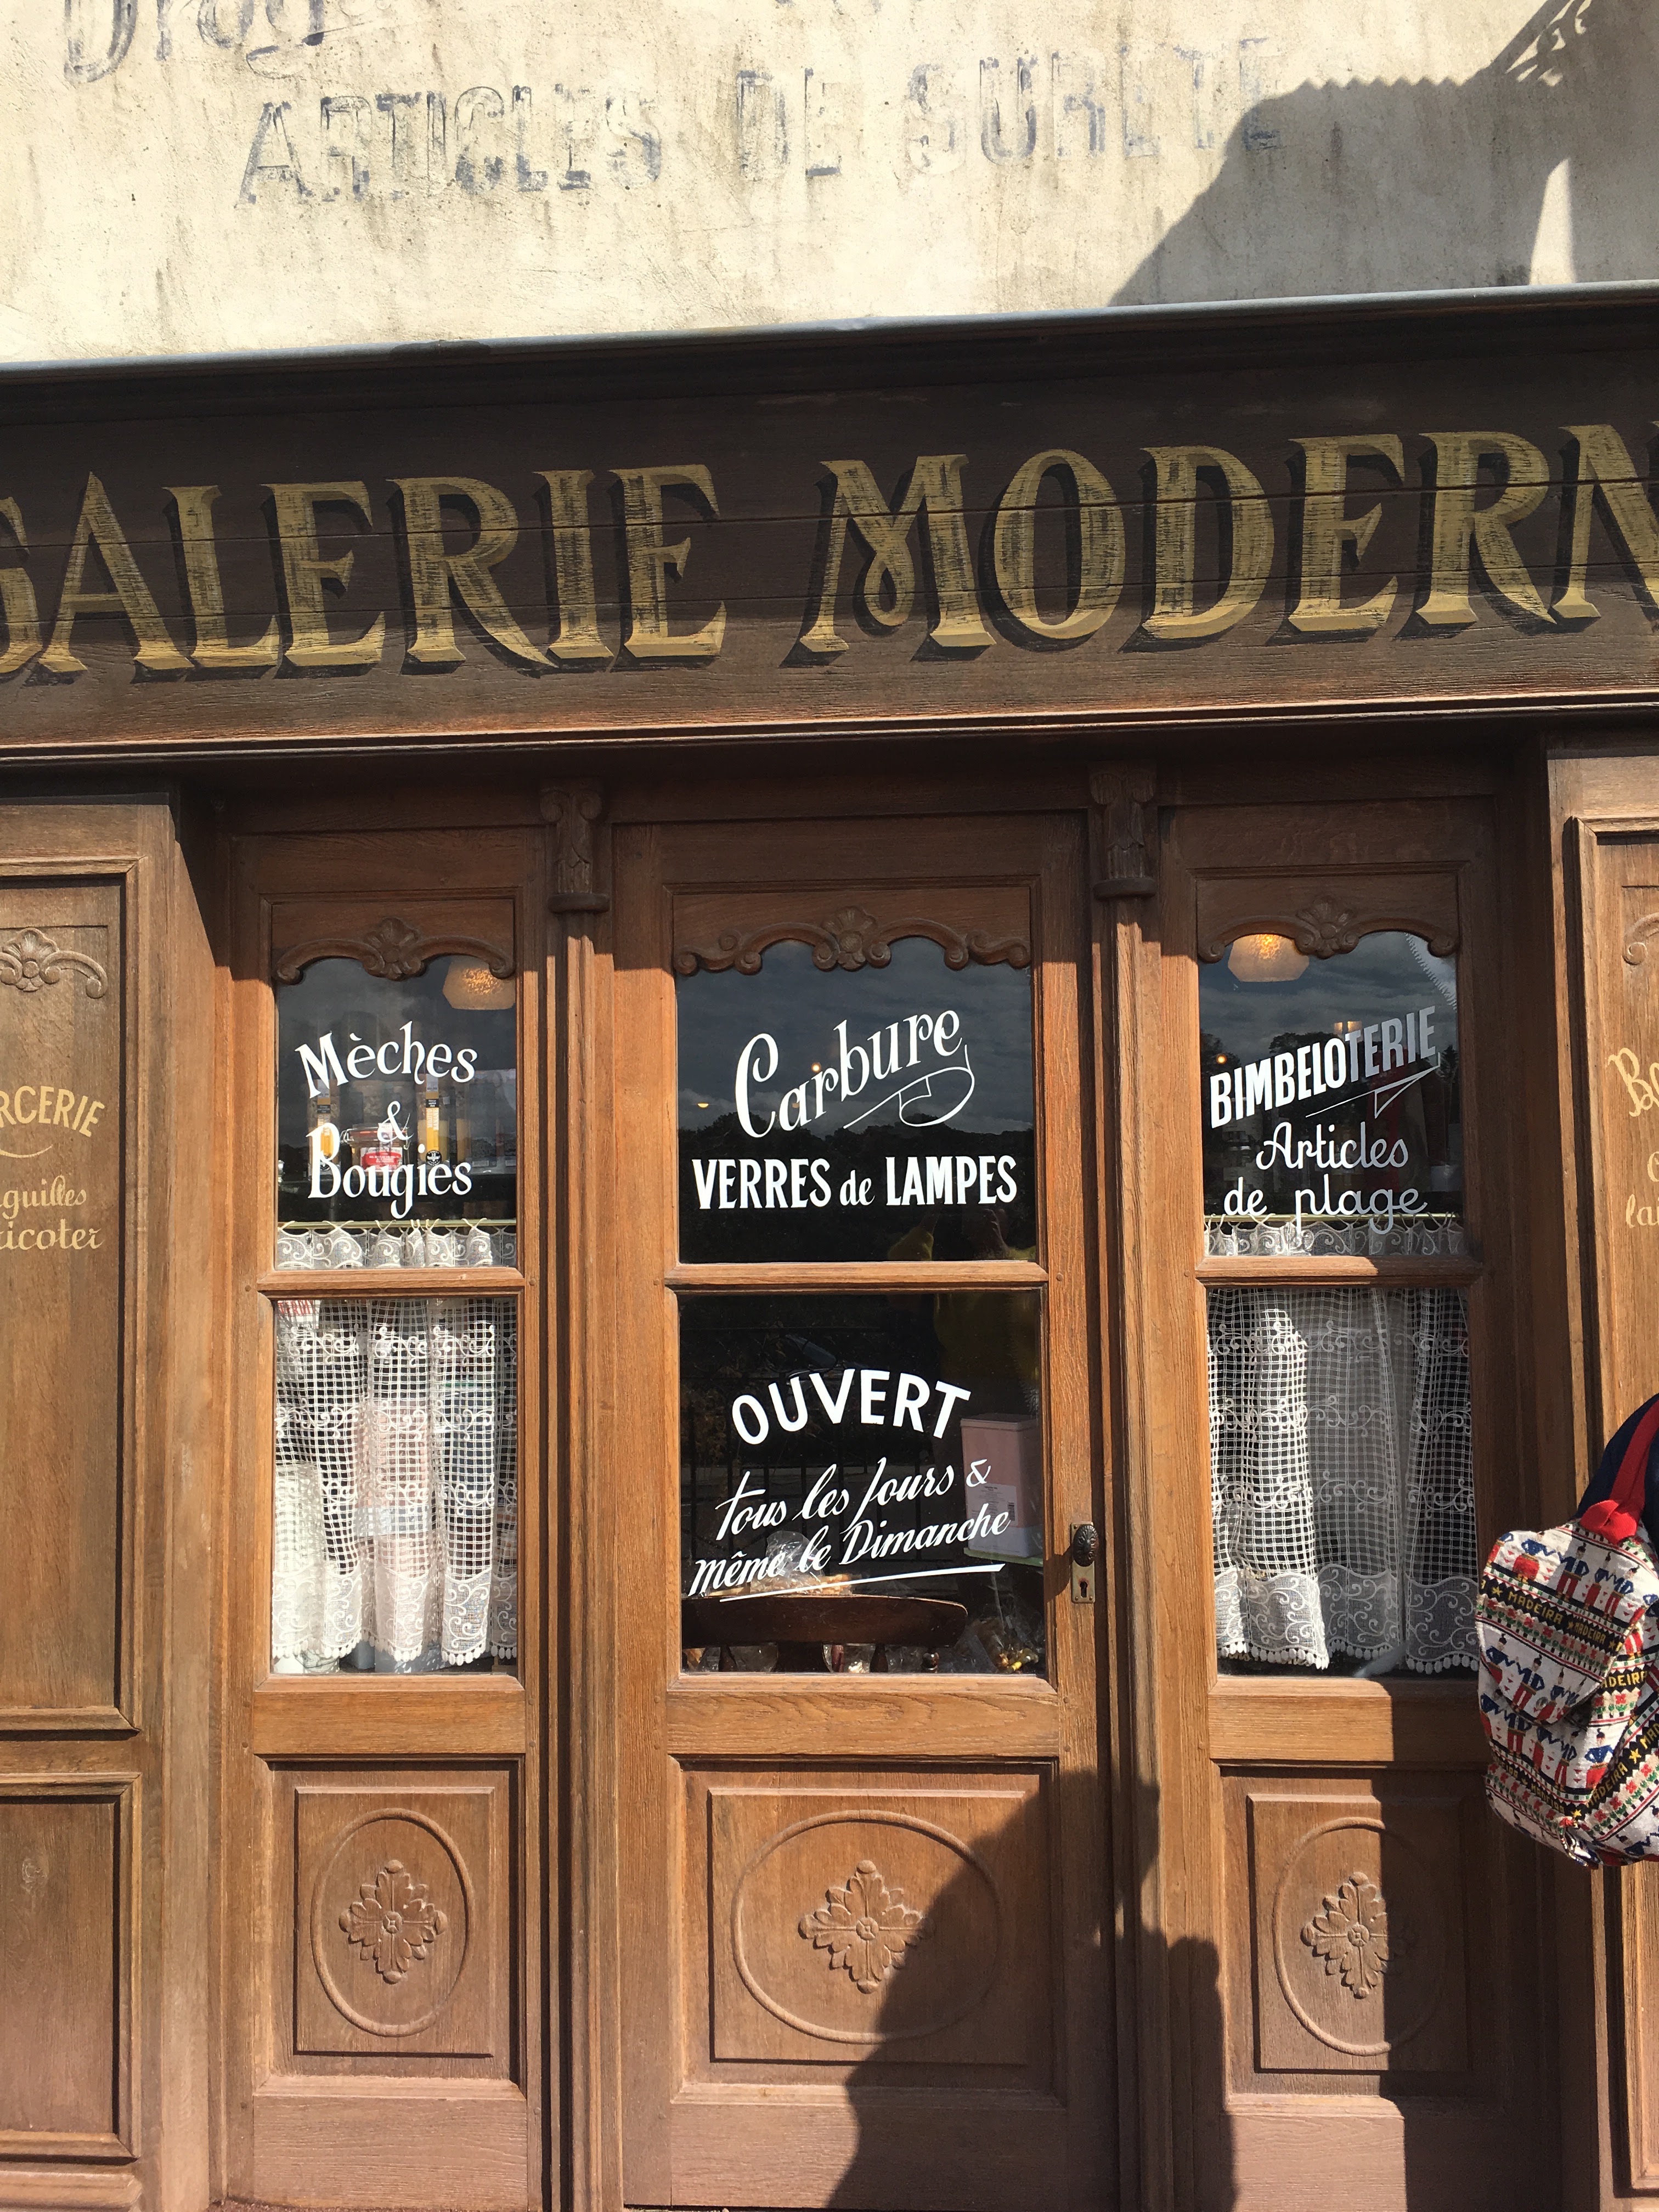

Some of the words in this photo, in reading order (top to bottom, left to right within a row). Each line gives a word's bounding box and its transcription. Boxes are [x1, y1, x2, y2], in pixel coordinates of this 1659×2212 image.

[234, 84, 660, 205] ARTICLES
[294, 1020, 478, 1099] Mèches
[734, 1009, 964, 1138] Carbure
[1210, 1006, 1436, 1129] BIMBELOTERIE
[376, 1100, 415, 1144] &
[1256, 1121, 1409, 1170] Articles
[305, 1122, 472, 1220] Bougies
[691, 1158, 832, 1210] VERRES
[839, 1169, 876, 1206] de
[885, 1155, 1017, 1206] LAMPES
[1223, 1176, 1268, 1216] de
[1295, 1173, 1429, 1237] plage
[0, 1218, 105, 1250] icoter
[731, 1368, 972, 1445] OUVERT
[714, 1471, 787, 1541] tous
[792, 1463, 849, 1521] les
[966, 1459, 991, 1487] &
[688, 1551, 785, 1596] même
[789, 1526, 832, 1573] le
[839, 1503, 1012, 1565] Dimanche
[1508, 1590, 1564, 1619] MADEIRA
